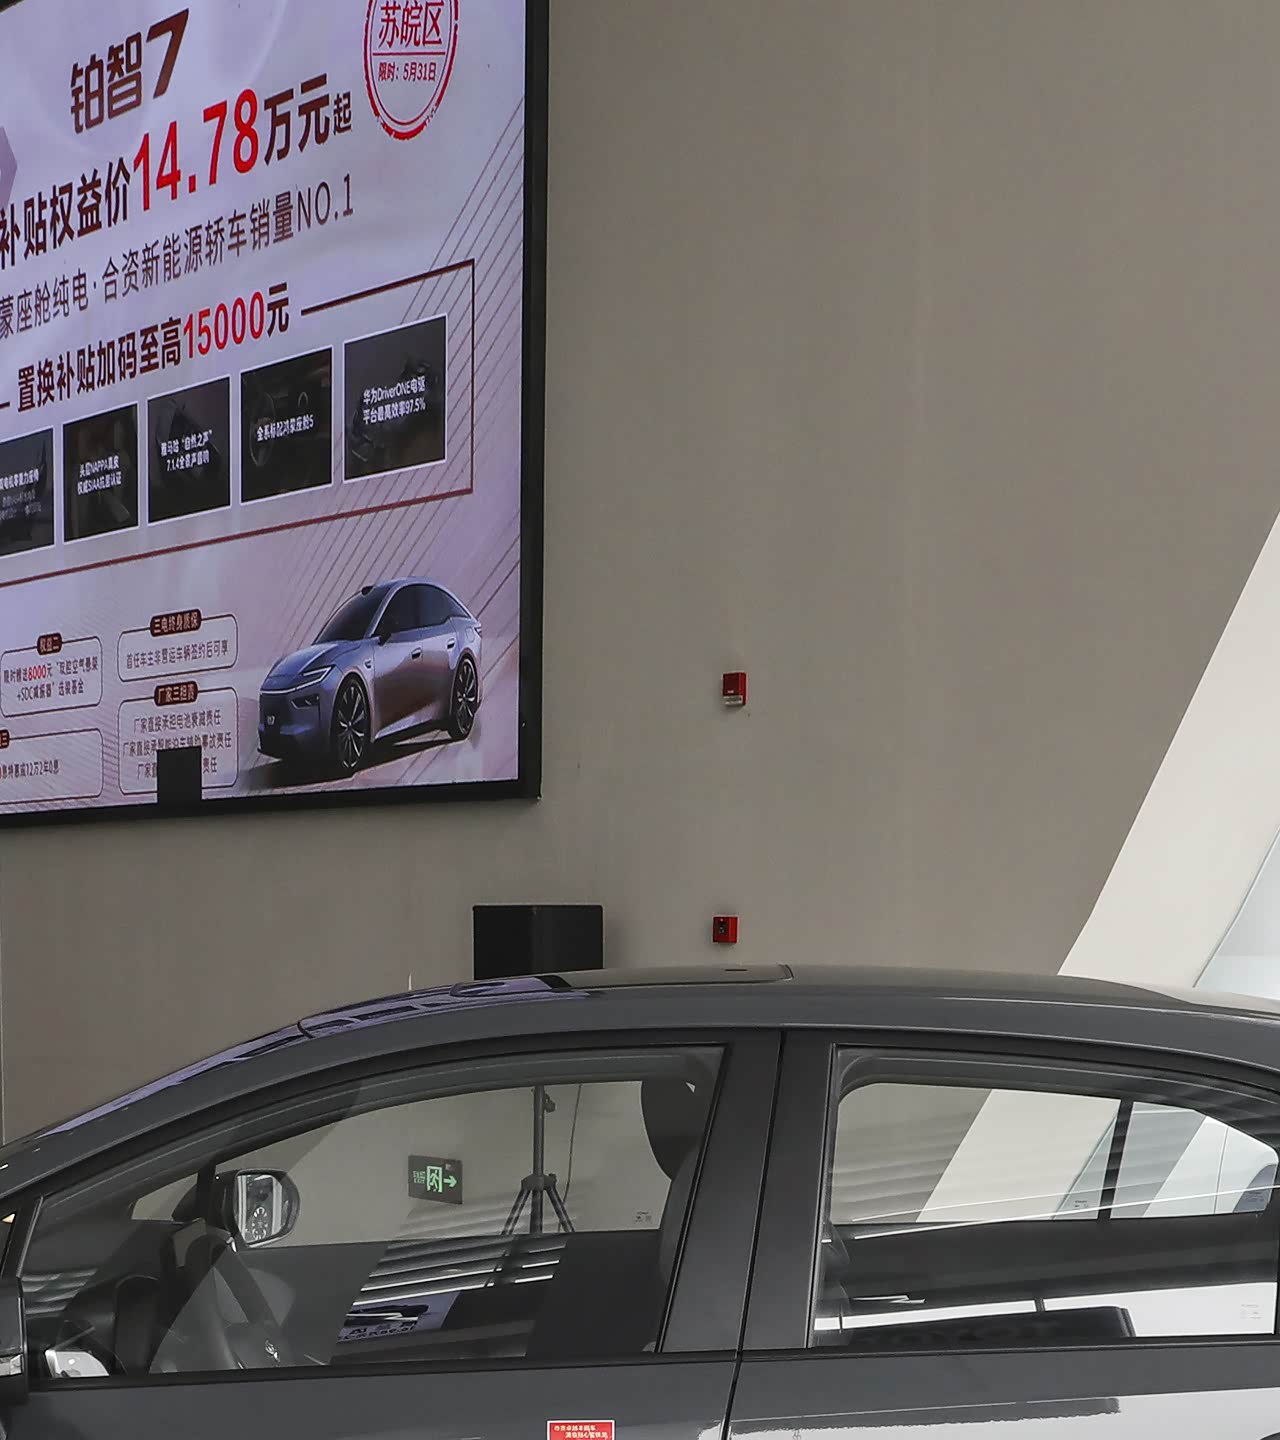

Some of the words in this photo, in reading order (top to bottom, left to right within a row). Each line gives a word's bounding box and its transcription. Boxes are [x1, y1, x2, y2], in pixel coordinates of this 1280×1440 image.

[71, 8, 190, 134] 铂智7
[379, 0, 444, 48] 苏皖区
[18, 283, 290, 412] 置换补贴加码至高15000元
